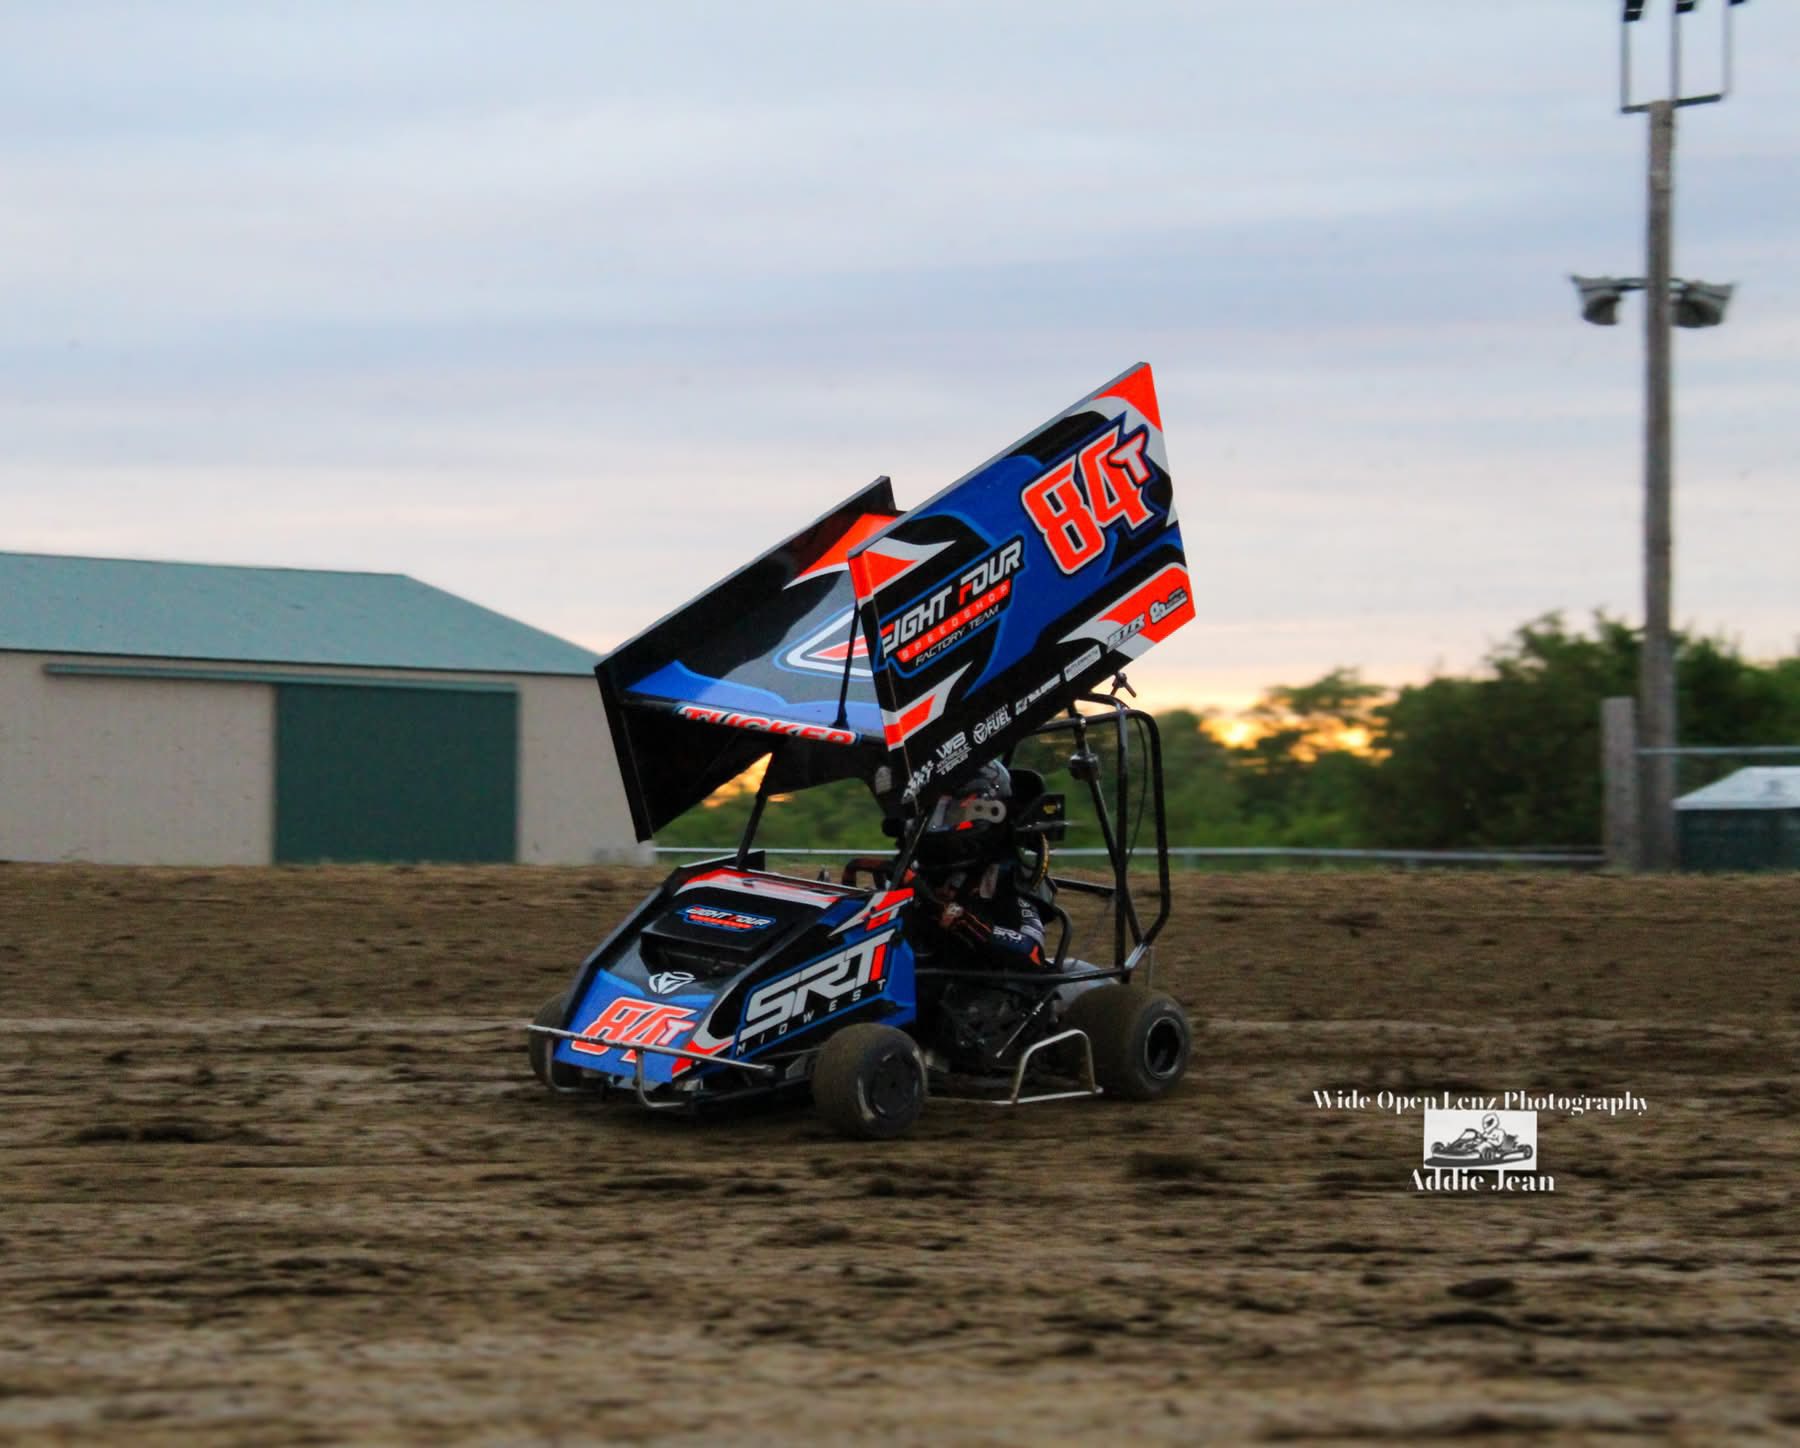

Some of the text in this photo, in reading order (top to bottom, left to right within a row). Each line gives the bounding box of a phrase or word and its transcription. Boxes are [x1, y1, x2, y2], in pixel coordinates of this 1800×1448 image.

[1021, 424, 1155, 575] 84T
[879, 540, 1022, 659] EIGHT FOUR
[914, 604, 999, 667] FACTORY TEAM
[986, 710, 1012, 736] FUEL
[570, 996, 698, 1063] 84T
